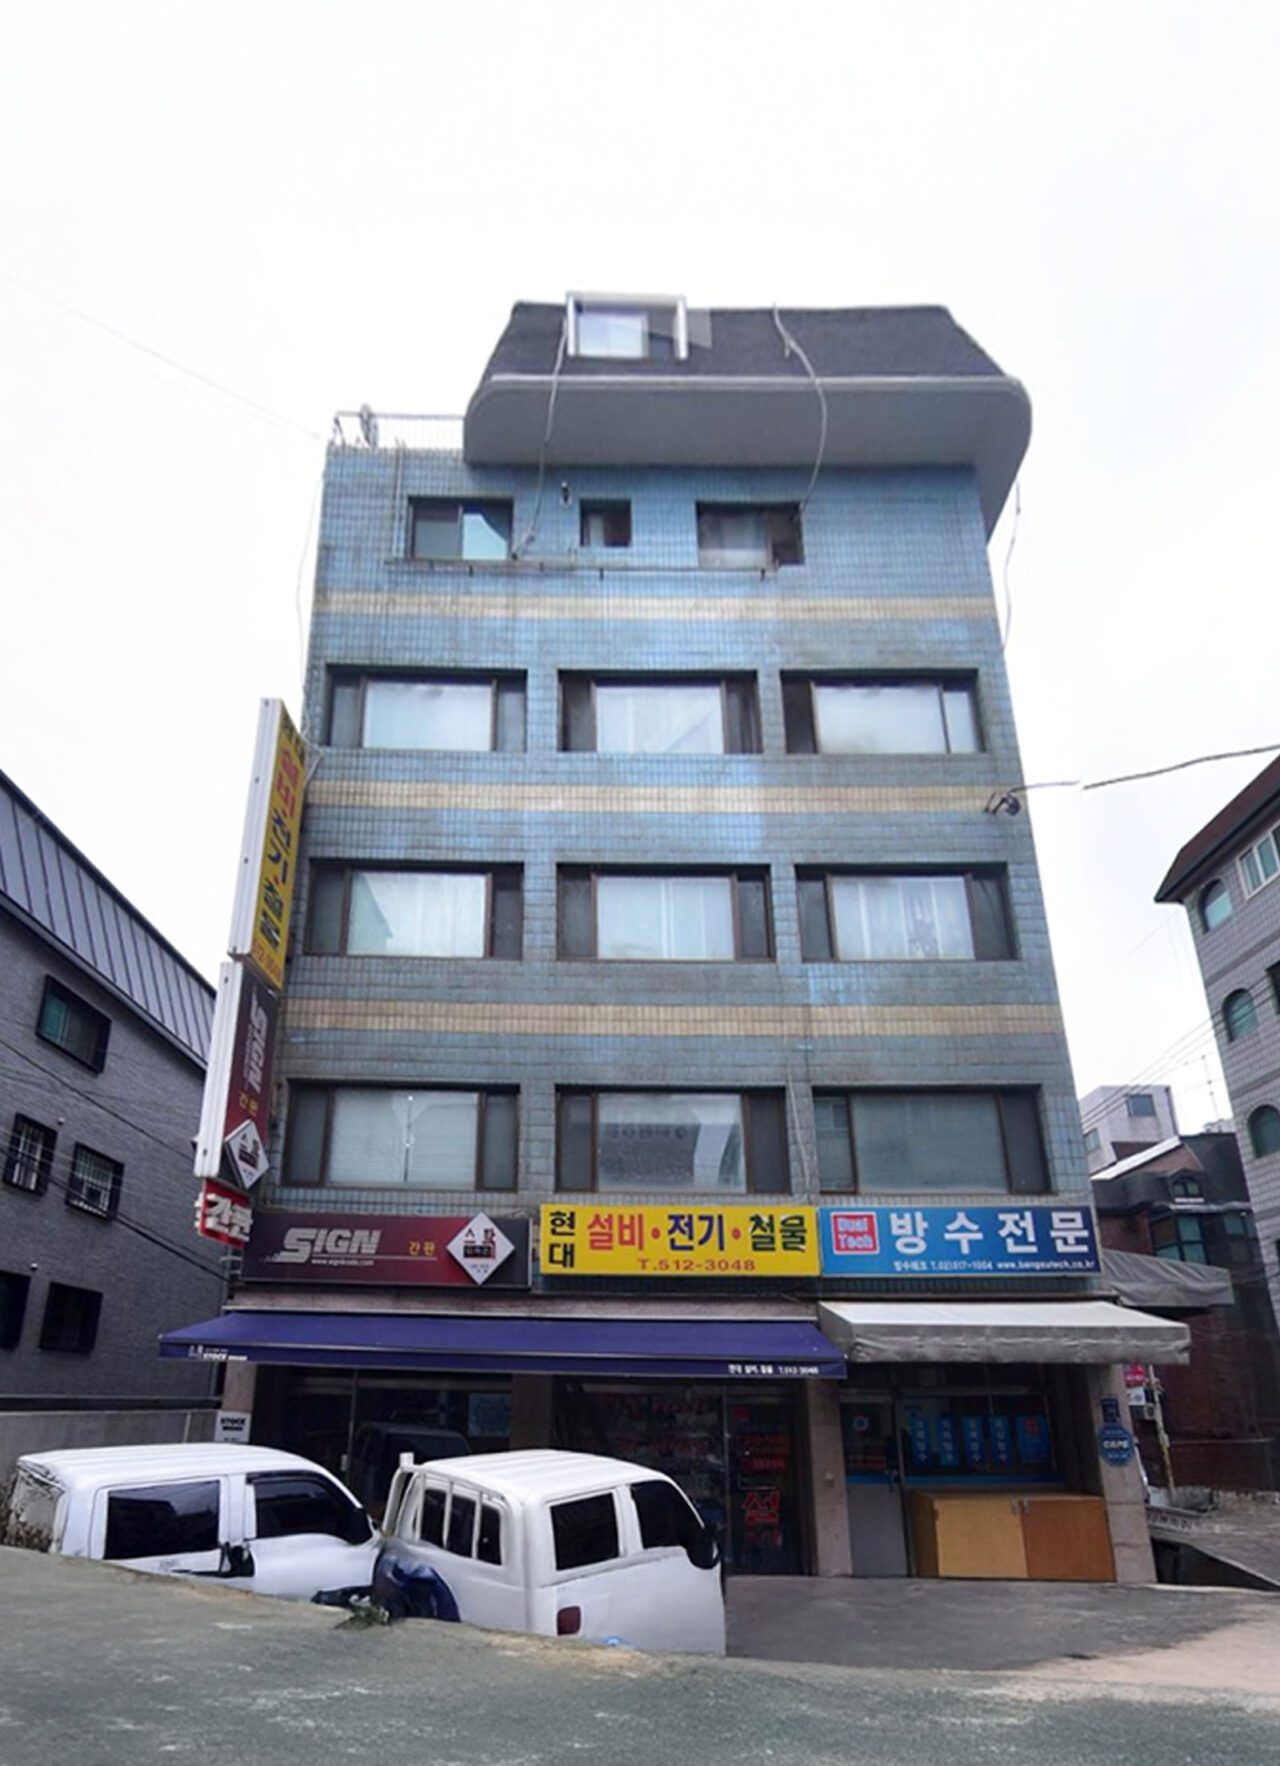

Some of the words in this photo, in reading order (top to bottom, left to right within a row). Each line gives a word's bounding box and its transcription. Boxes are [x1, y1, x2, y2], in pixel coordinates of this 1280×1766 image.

[205, 1193, 254, 1243] 간판
[587, 1213, 644, 1251] 설비
[667, 1214, 725, 1251] 전기
[889, 1211, 1090, 1255] 방수전문
[278, 1228, 382, 1263] SIGN
[549, 1211, 575, 1268] 현대
[837, 1234, 874, 1249] Tech
[637, 1258, 756, 1272] T.512-3048
